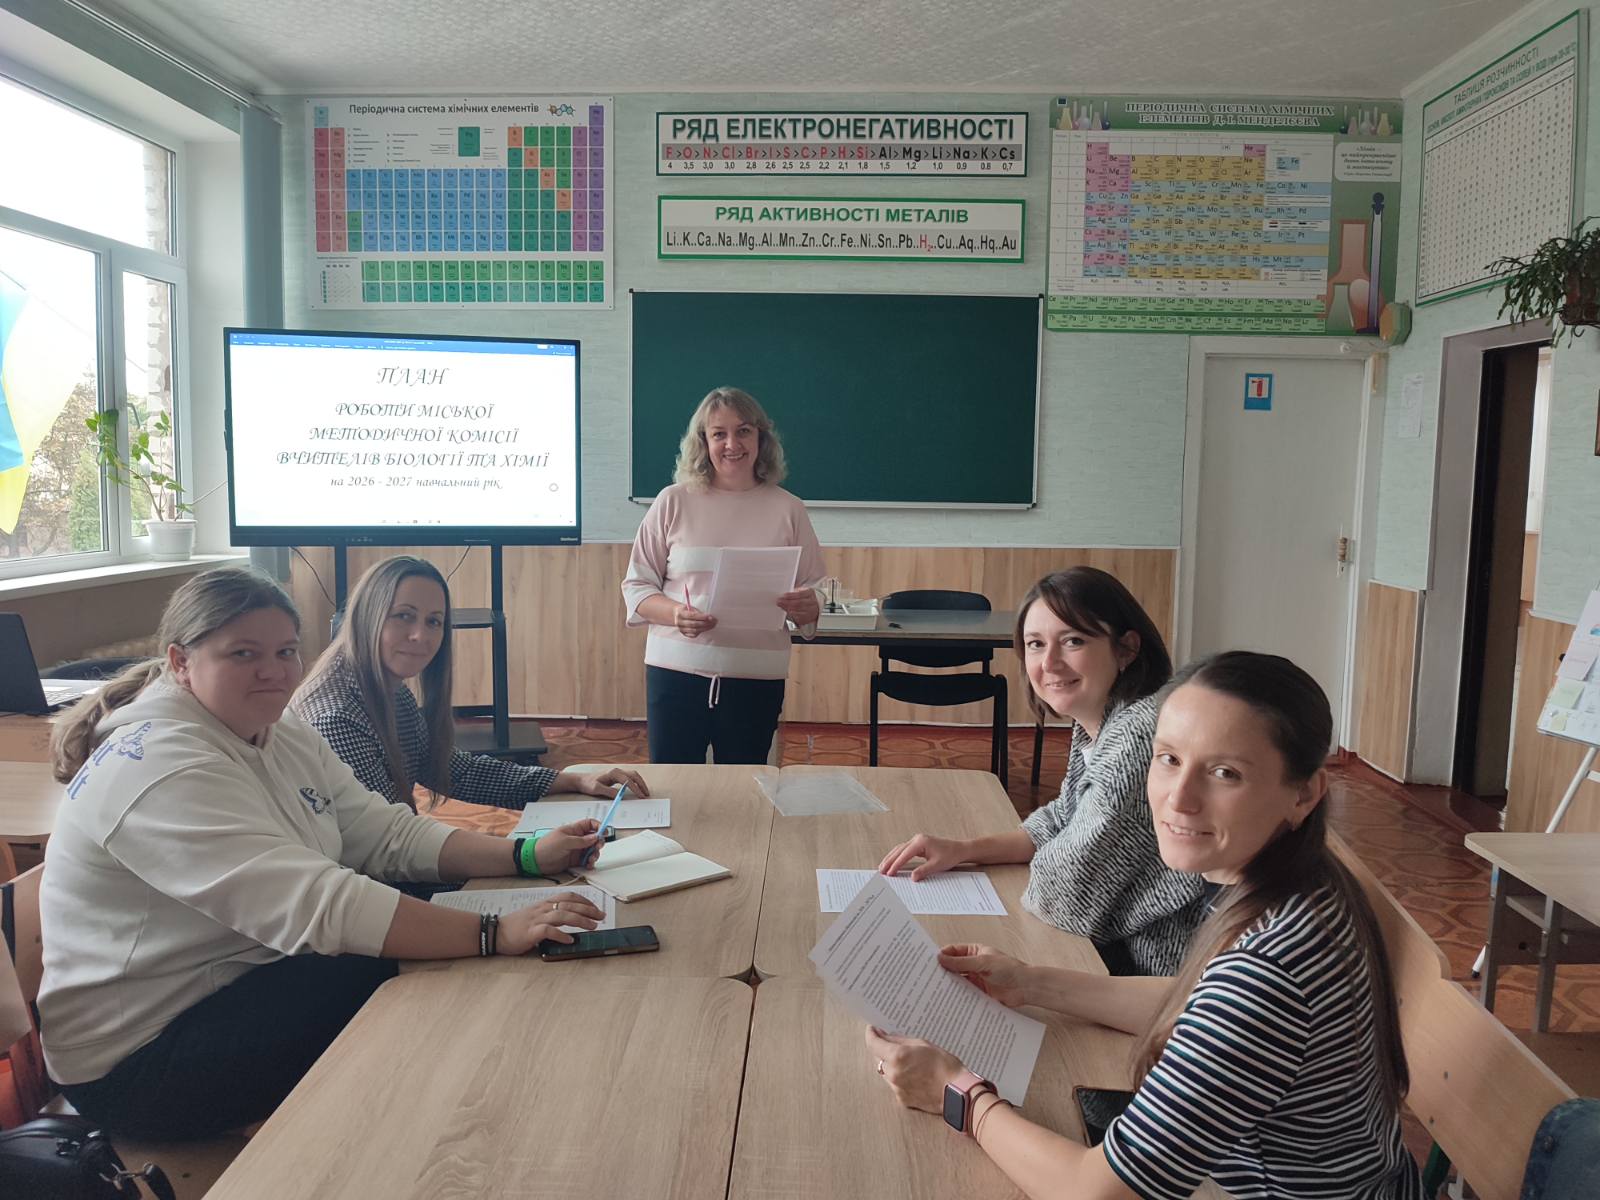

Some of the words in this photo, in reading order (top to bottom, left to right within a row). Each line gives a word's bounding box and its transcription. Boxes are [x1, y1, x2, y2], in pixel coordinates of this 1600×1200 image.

[349, 104, 405, 115] Періодична
[448, 103, 488, 113] хімічних
[491, 103, 539, 113] елементів
[1210, 103, 1267, 114] СИСТЕМА
[672, 118, 719, 142] РЯД
[727, 118, 1014, 139] ЕЛЕКТРОНЕГАТИВНОСТІ
[716, 207, 753, 223] РЯД
[759, 207, 879, 222] АКТИВНОСТІ
[885, 208, 969, 223] МЕТАЛІВ
[376, 366, 450, 387] ПЛАН
[335, 403, 416, 416] РОБОТИ
[417, 404, 495, 420] МІСЬКОЇ
[309, 427, 444, 442] МЕТОДИЧНОЇ
[447, 427, 519, 444] КОМІСІЇ
[277, 451, 380, 467] ВЧИТЕЛІВ
[384, 451, 464, 467] БІОЛОГІЇ
[466, 453, 496, 468] ТА
[500, 452, 550, 468] ХІМІЇ
[330, 478, 344, 486] на
[347, 476, 375, 487] 2026
[385, 476, 412, 487] 2027
[416, 477, 480, 487] навчальний
[483, 477, 503, 490] рік
